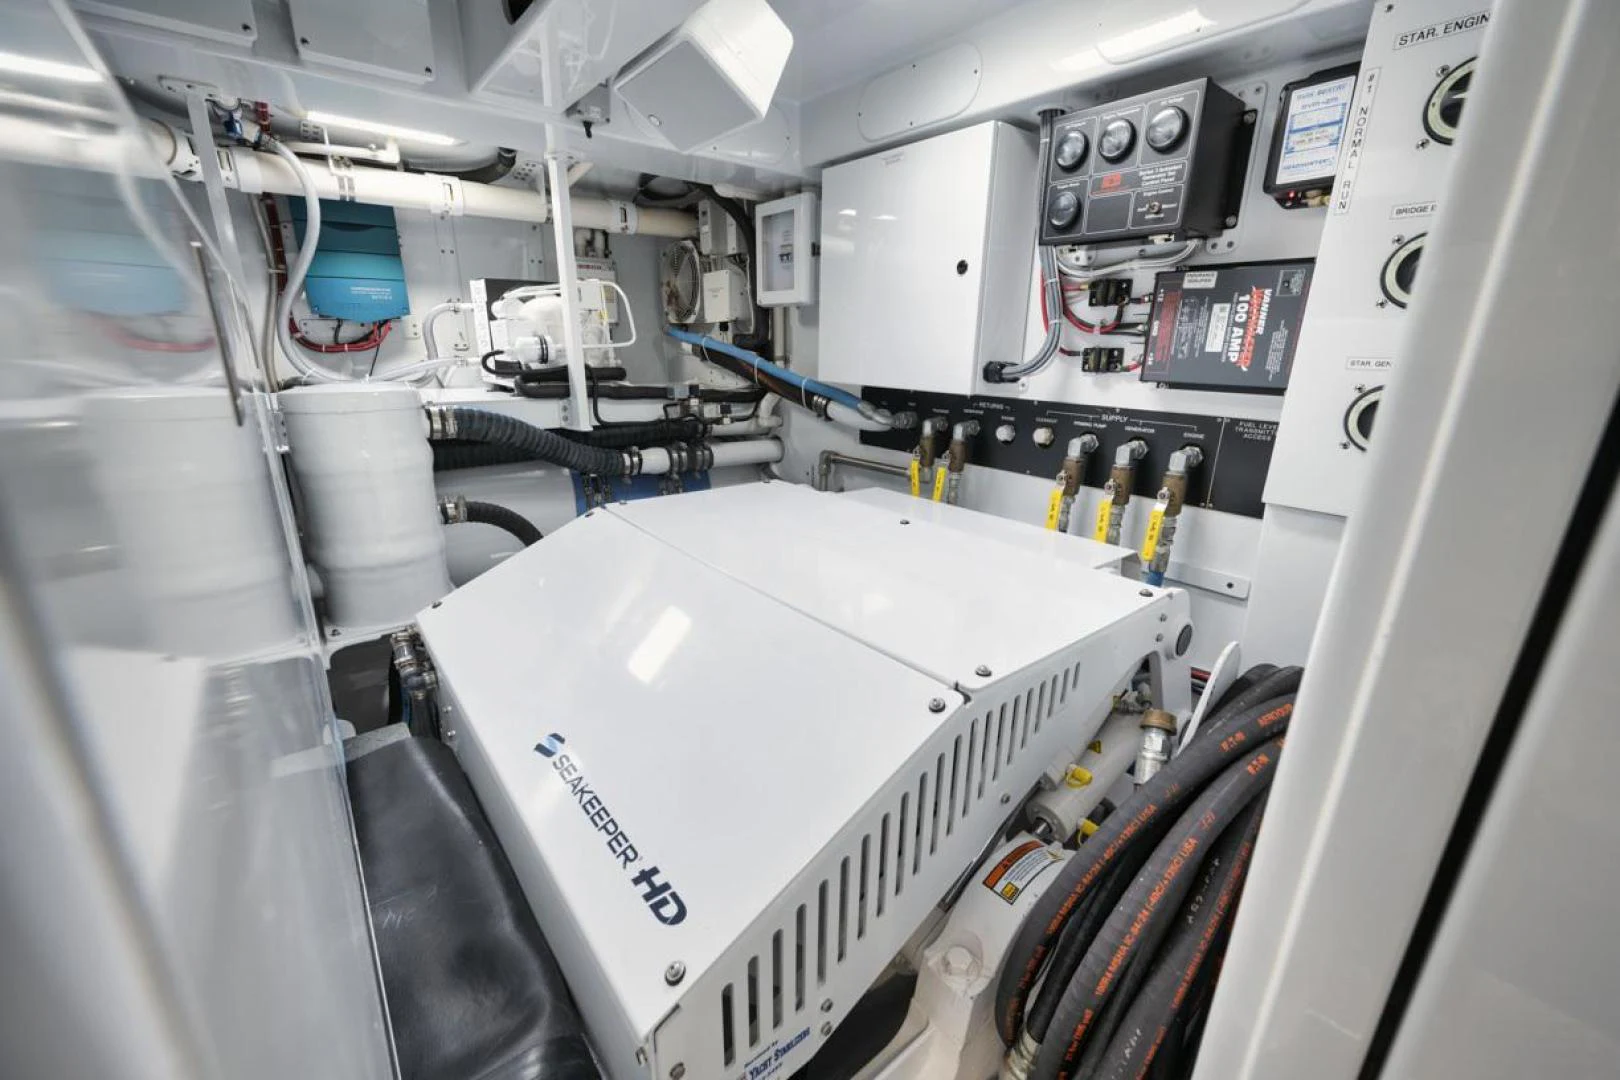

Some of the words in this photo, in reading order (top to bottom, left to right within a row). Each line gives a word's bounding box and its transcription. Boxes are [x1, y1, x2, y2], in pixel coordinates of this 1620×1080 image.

[1399, 27, 1439, 46] STAR.
[1348, 106, 1368, 169] NORMAL
[1338, 180, 1351, 209] RUN
[1395, 204, 1429, 215] BRIDGE
[1234, 294, 1250, 323] 100
[1256, 288, 1272, 335] VANNER
[1227, 327, 1244, 363] AMP
[1101, 414, 1128, 423] SUPPLY
[1243, 433, 1271, 441] ACCESS
[553, 753, 639, 870] SEAKEEPER
[631, 866, 688, 926] HD
